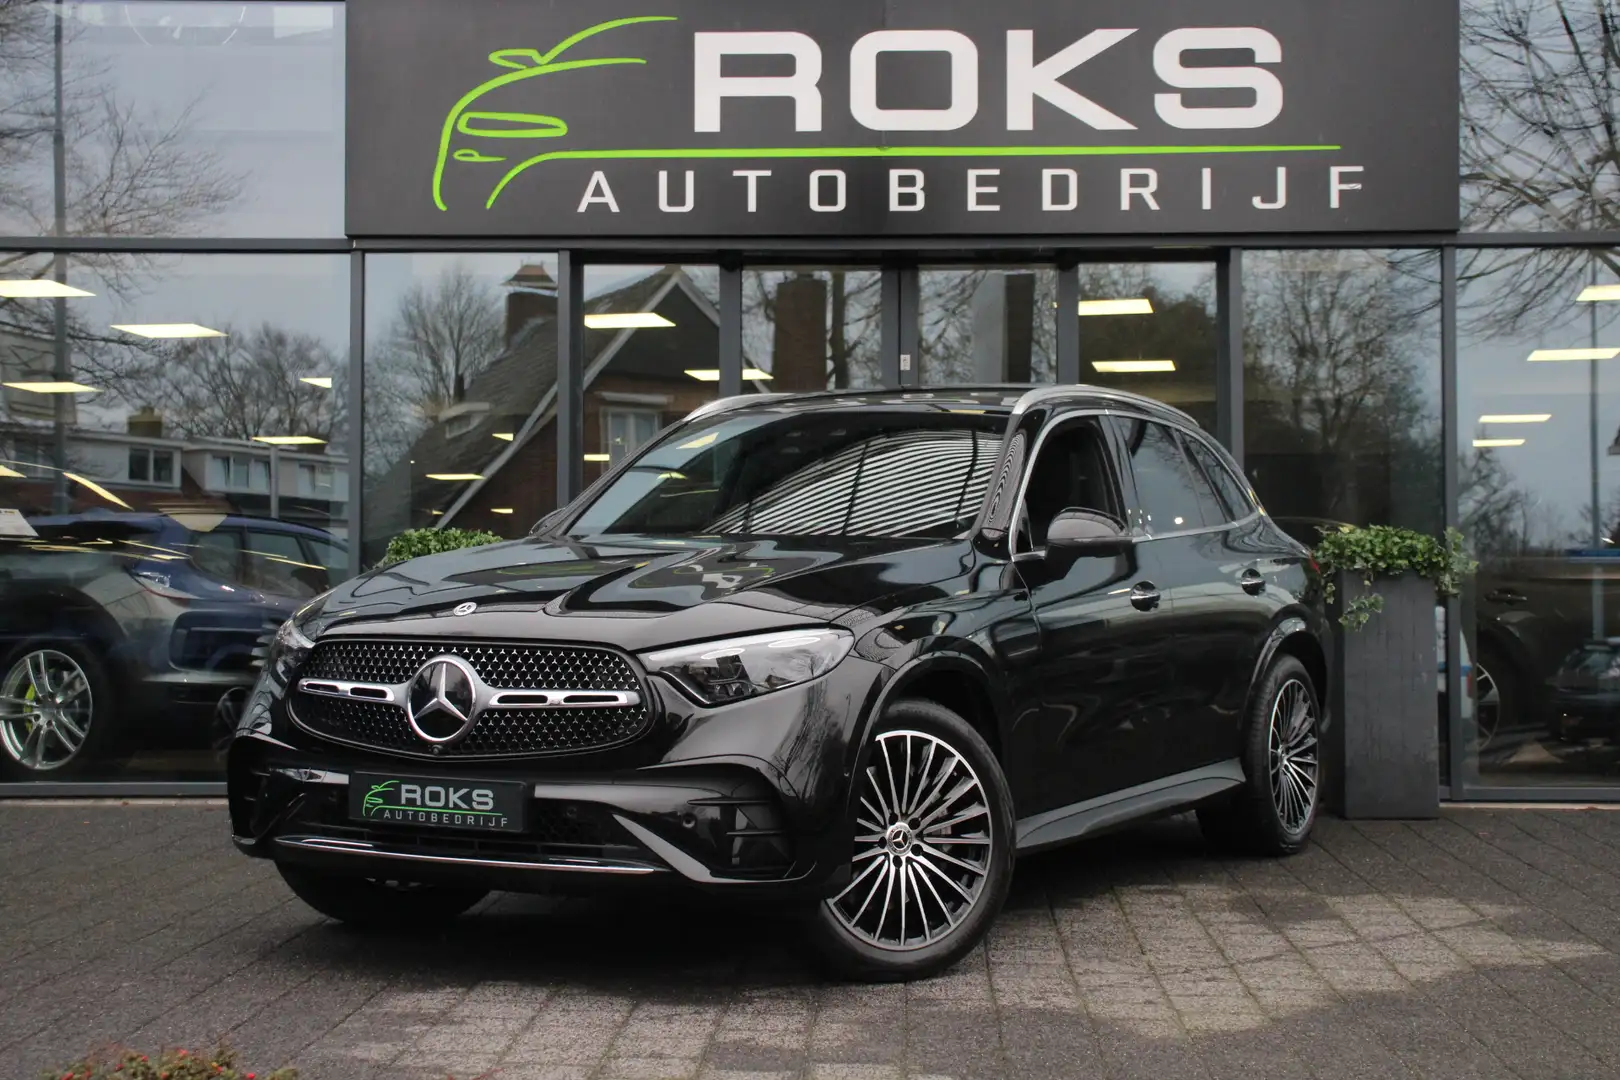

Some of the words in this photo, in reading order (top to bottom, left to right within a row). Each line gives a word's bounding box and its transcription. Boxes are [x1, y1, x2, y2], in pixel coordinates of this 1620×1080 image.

[694, 27, 1283, 133] ROKS
[577, 165, 1364, 214] AUTOBEDRIJF
[401, 784, 494, 810] ROKS
[383, 809, 508, 827] AUTOBEDRIJF
